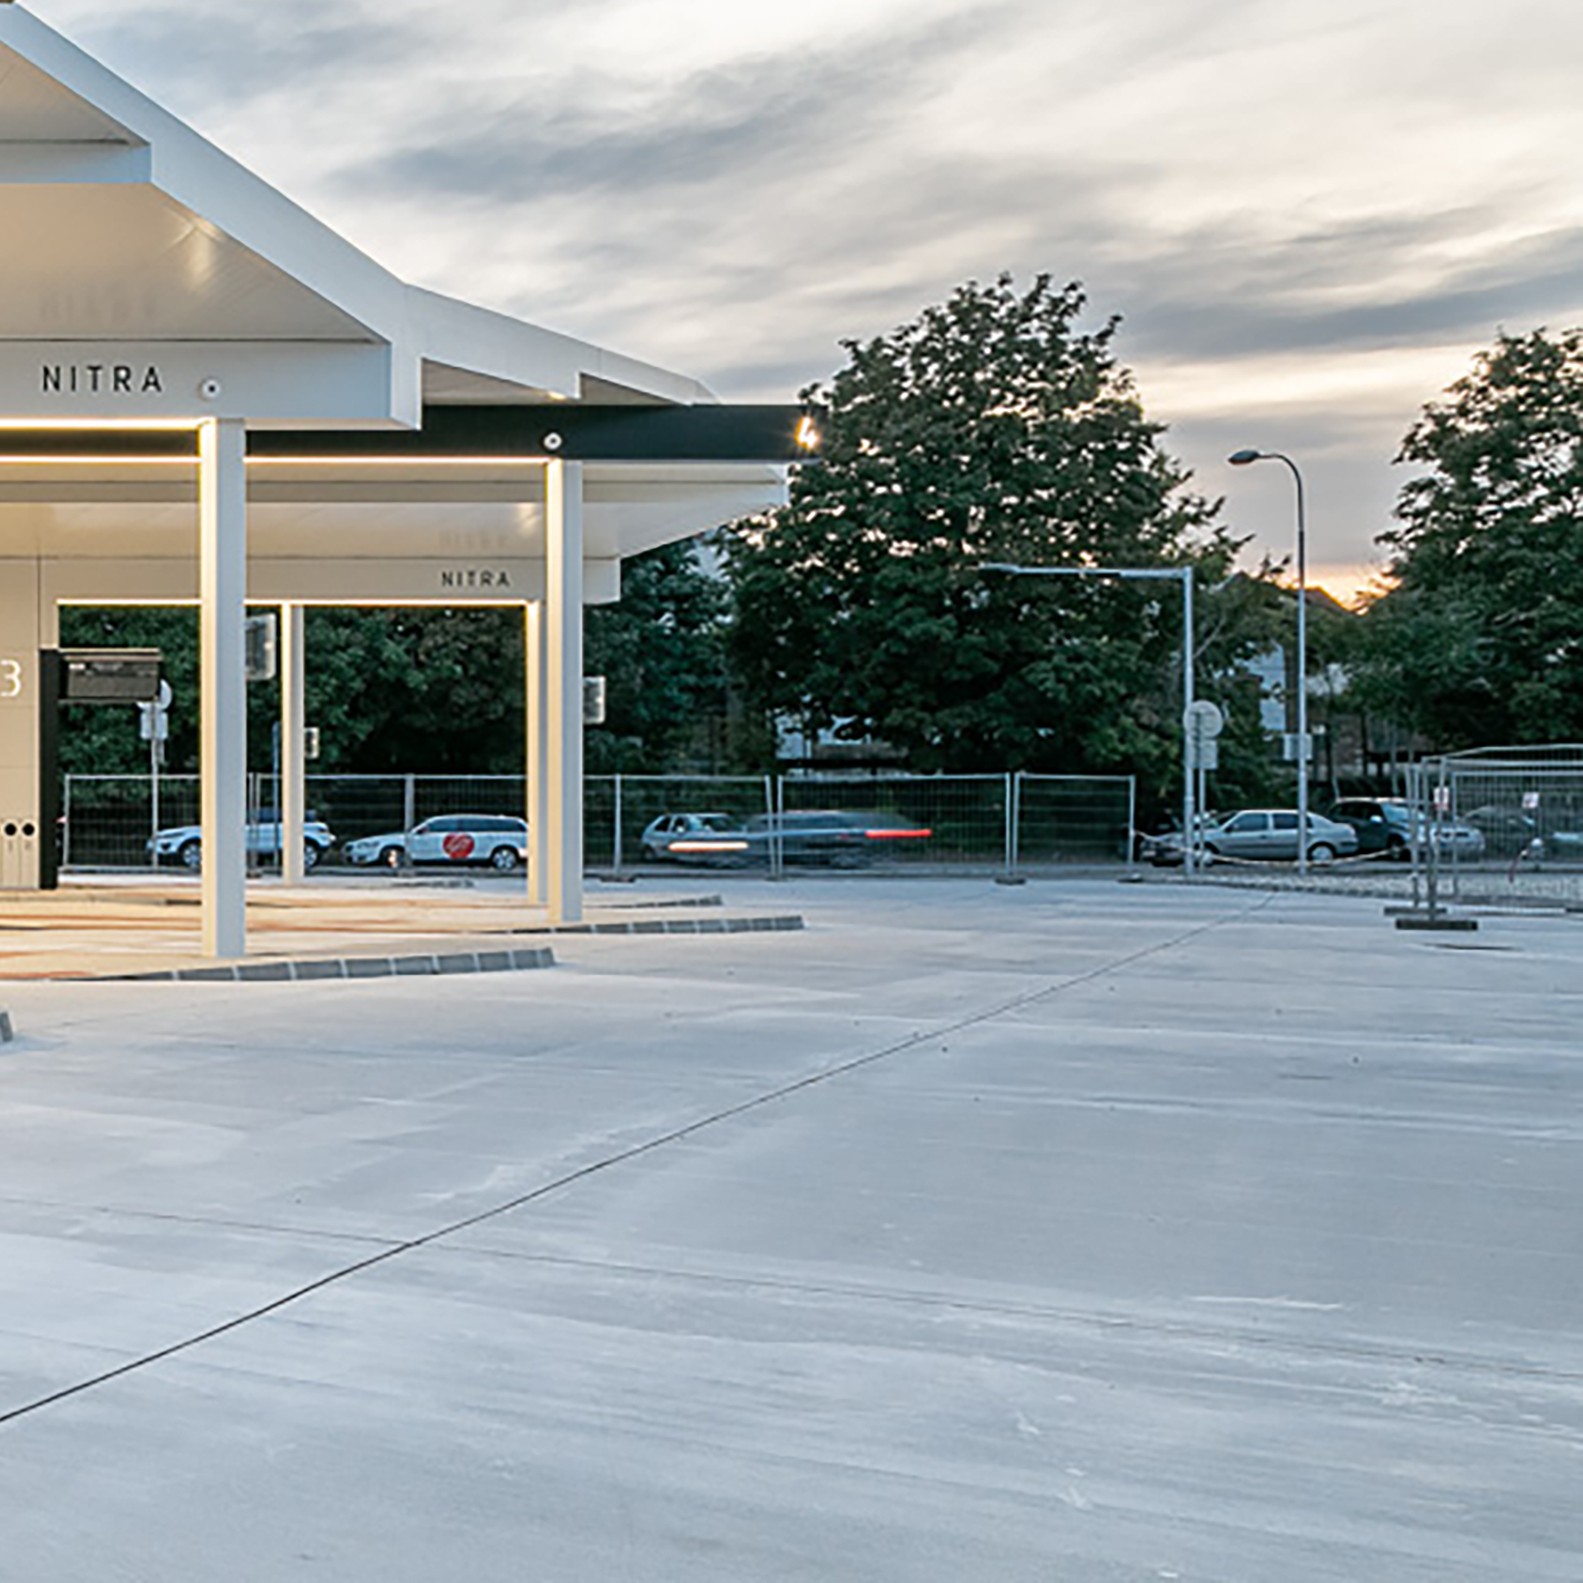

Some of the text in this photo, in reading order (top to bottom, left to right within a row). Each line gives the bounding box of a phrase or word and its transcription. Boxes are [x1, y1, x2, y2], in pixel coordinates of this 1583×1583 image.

[42, 365, 163, 392] NITRA
[798, 416, 819, 449] 4
[440, 569, 511, 588] NITRA
[0, 659, 22, 698] 3
